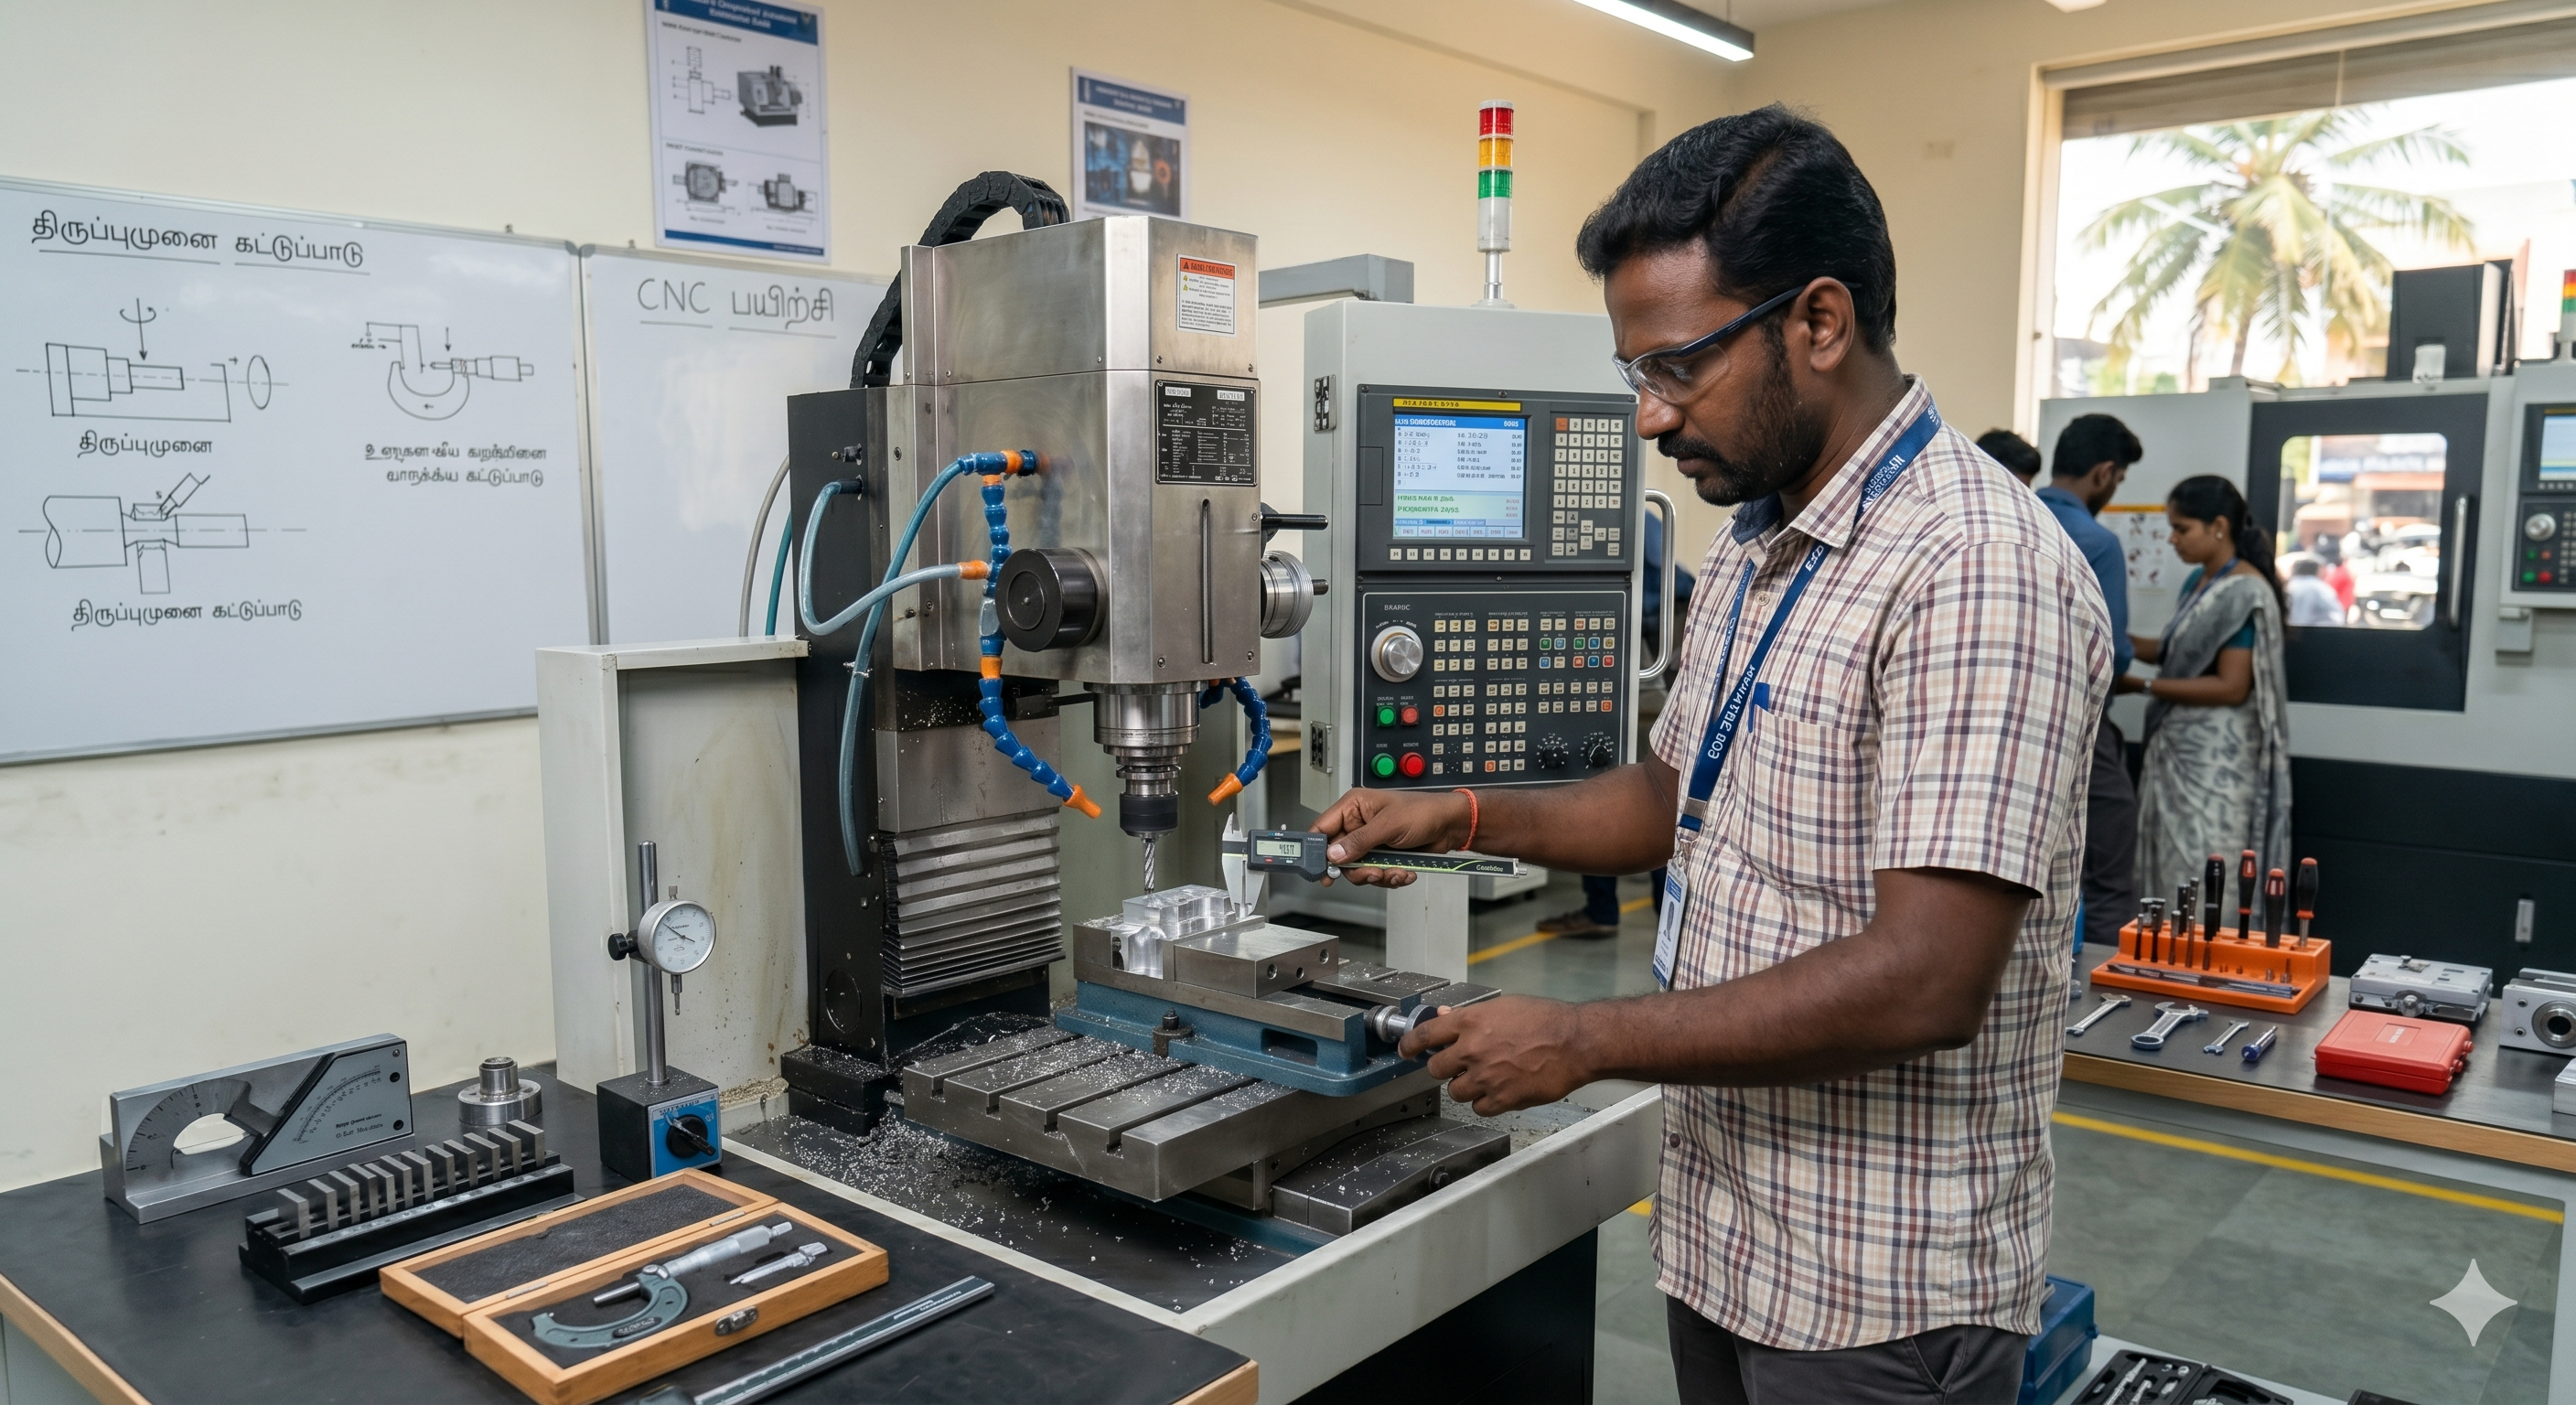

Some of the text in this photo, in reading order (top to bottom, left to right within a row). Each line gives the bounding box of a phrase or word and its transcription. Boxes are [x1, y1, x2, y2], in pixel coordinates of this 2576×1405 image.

[32, 209, 364, 268] திருப்புமுனை கட்டுப்பாடு
[638, 278, 834, 329] CNC பயிற்சி
[77, 429, 212, 458] திருப்புமுனை
[71, 598, 302, 631] திருப்புமுனை கட்டுப்பாடு
